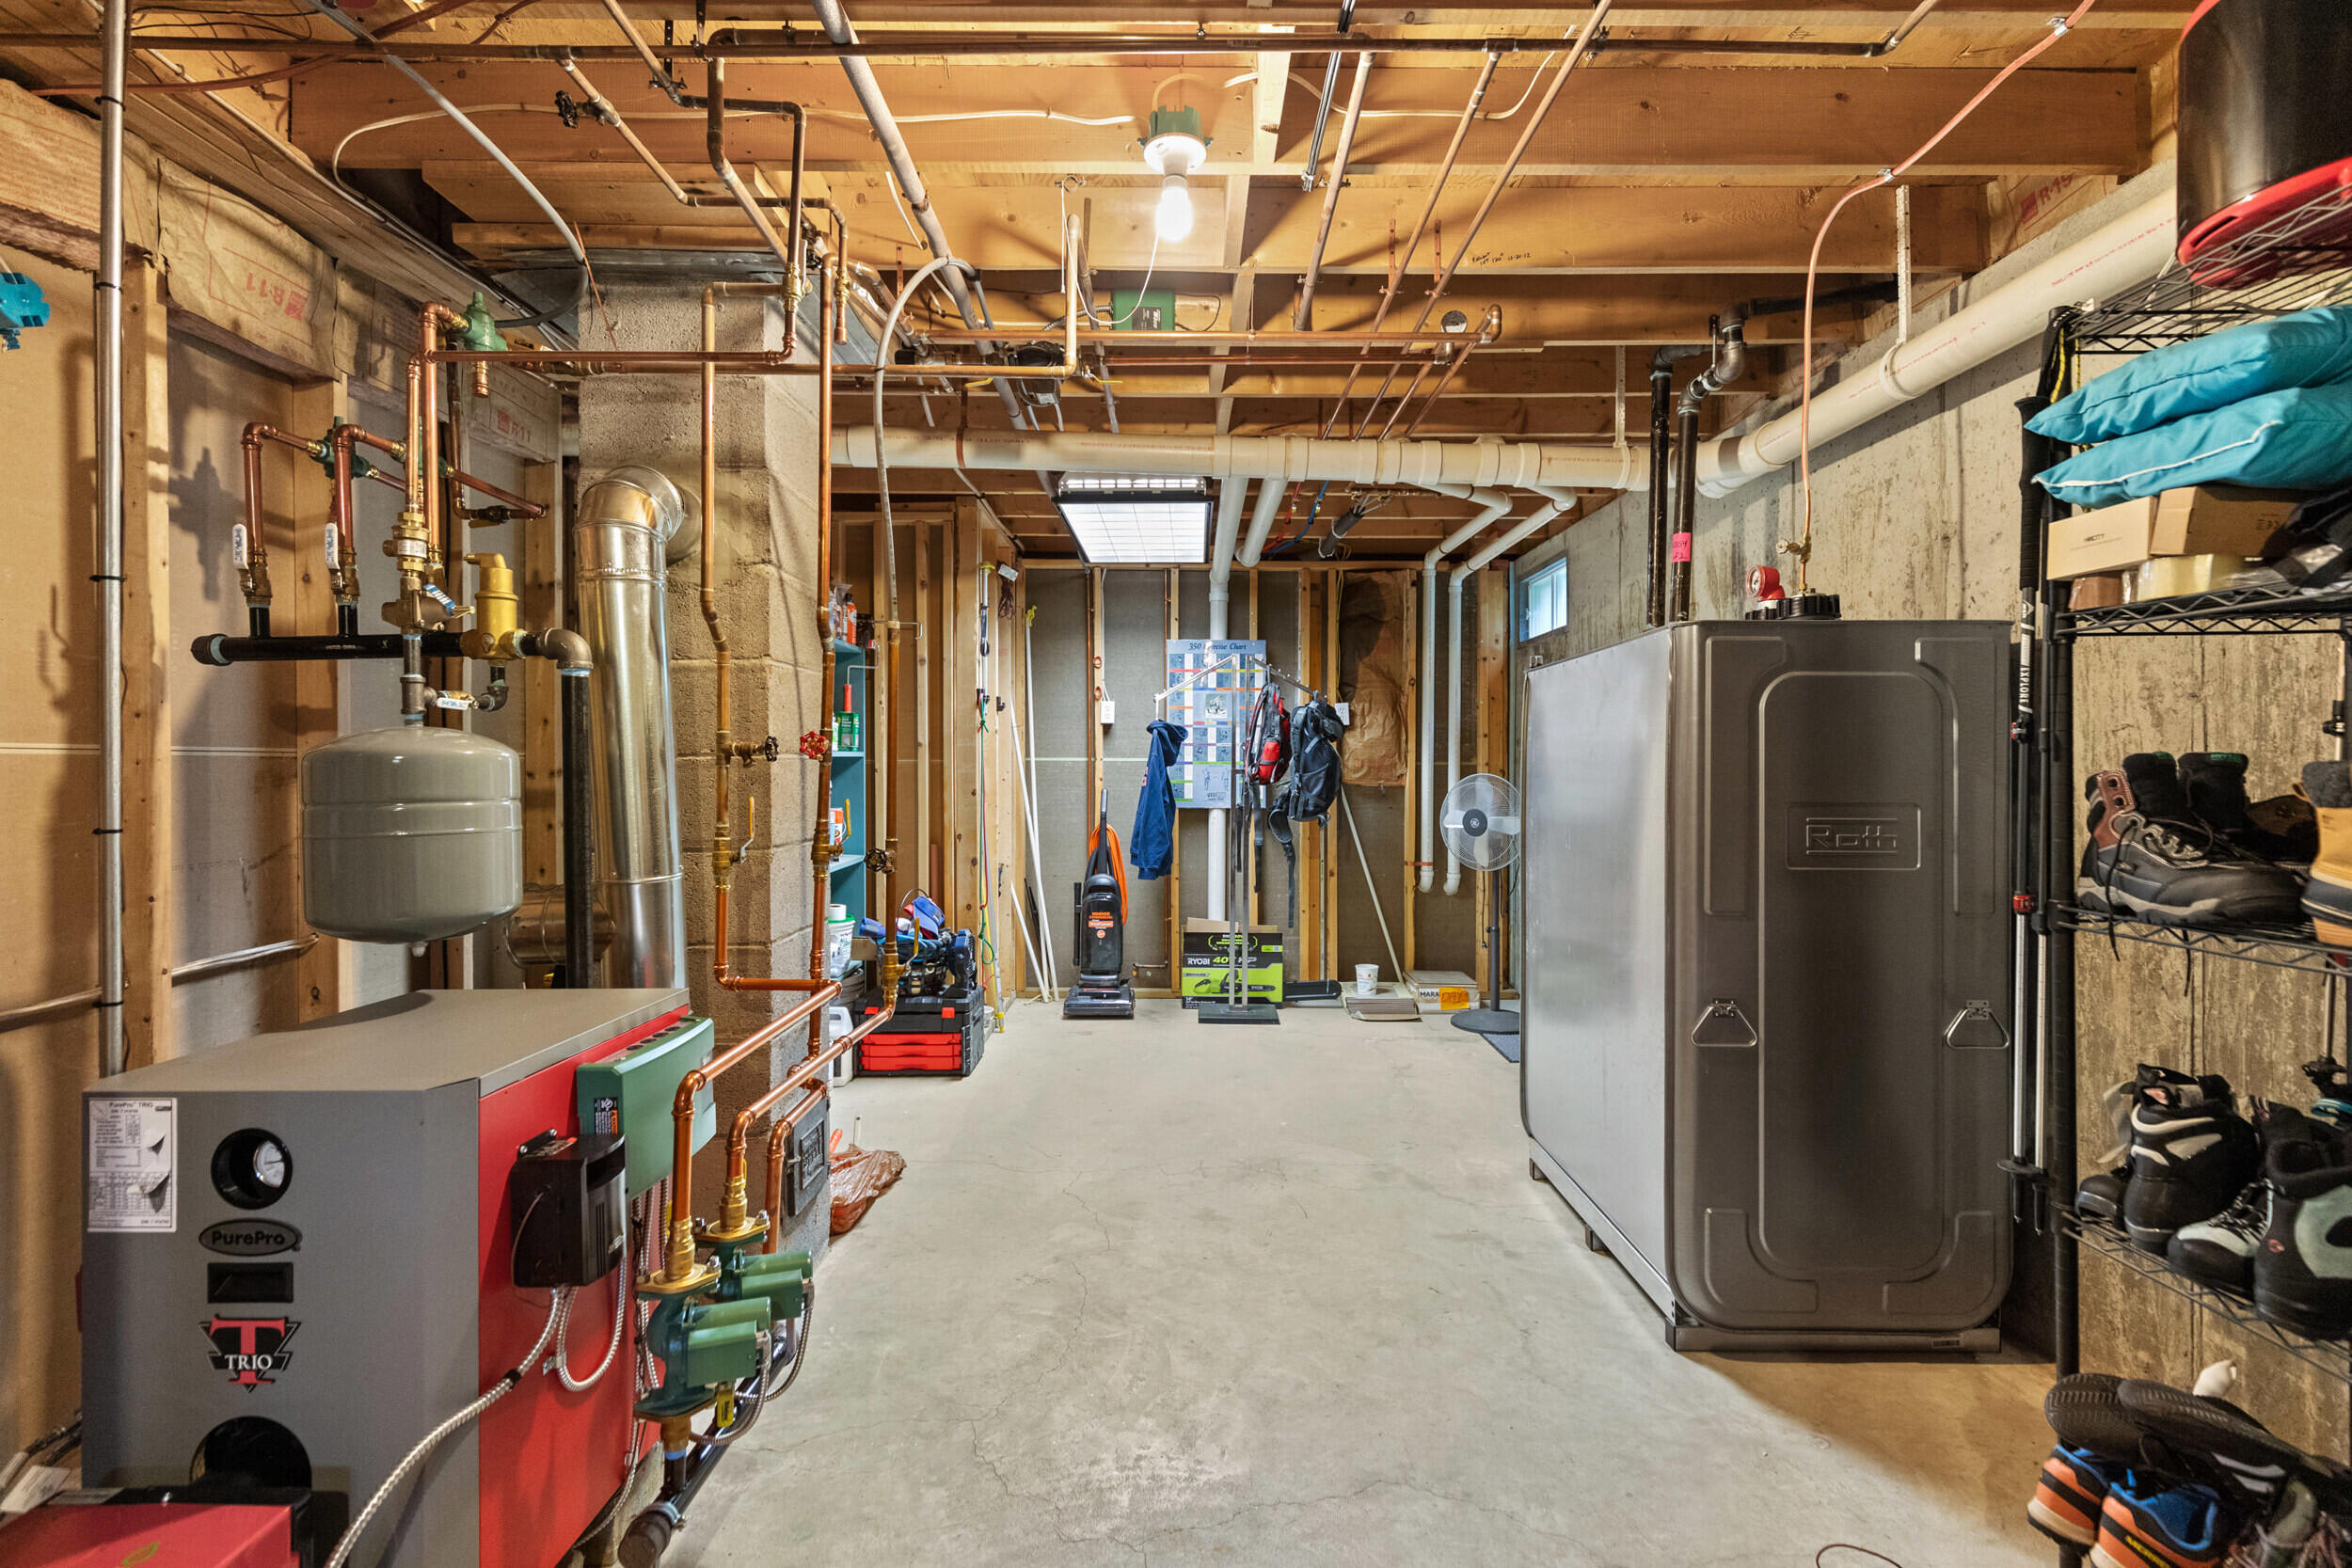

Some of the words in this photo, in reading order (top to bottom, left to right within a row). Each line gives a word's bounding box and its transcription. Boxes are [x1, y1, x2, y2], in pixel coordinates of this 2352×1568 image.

[1189, 642, 1201, 651] 350
[2019, 667, 2030, 705] EXPLORE
[1806, 825, 1898, 847] Roth
[211, 1230, 286, 1247] PurePro
[224, 1354, 274, 1370] TRIO
